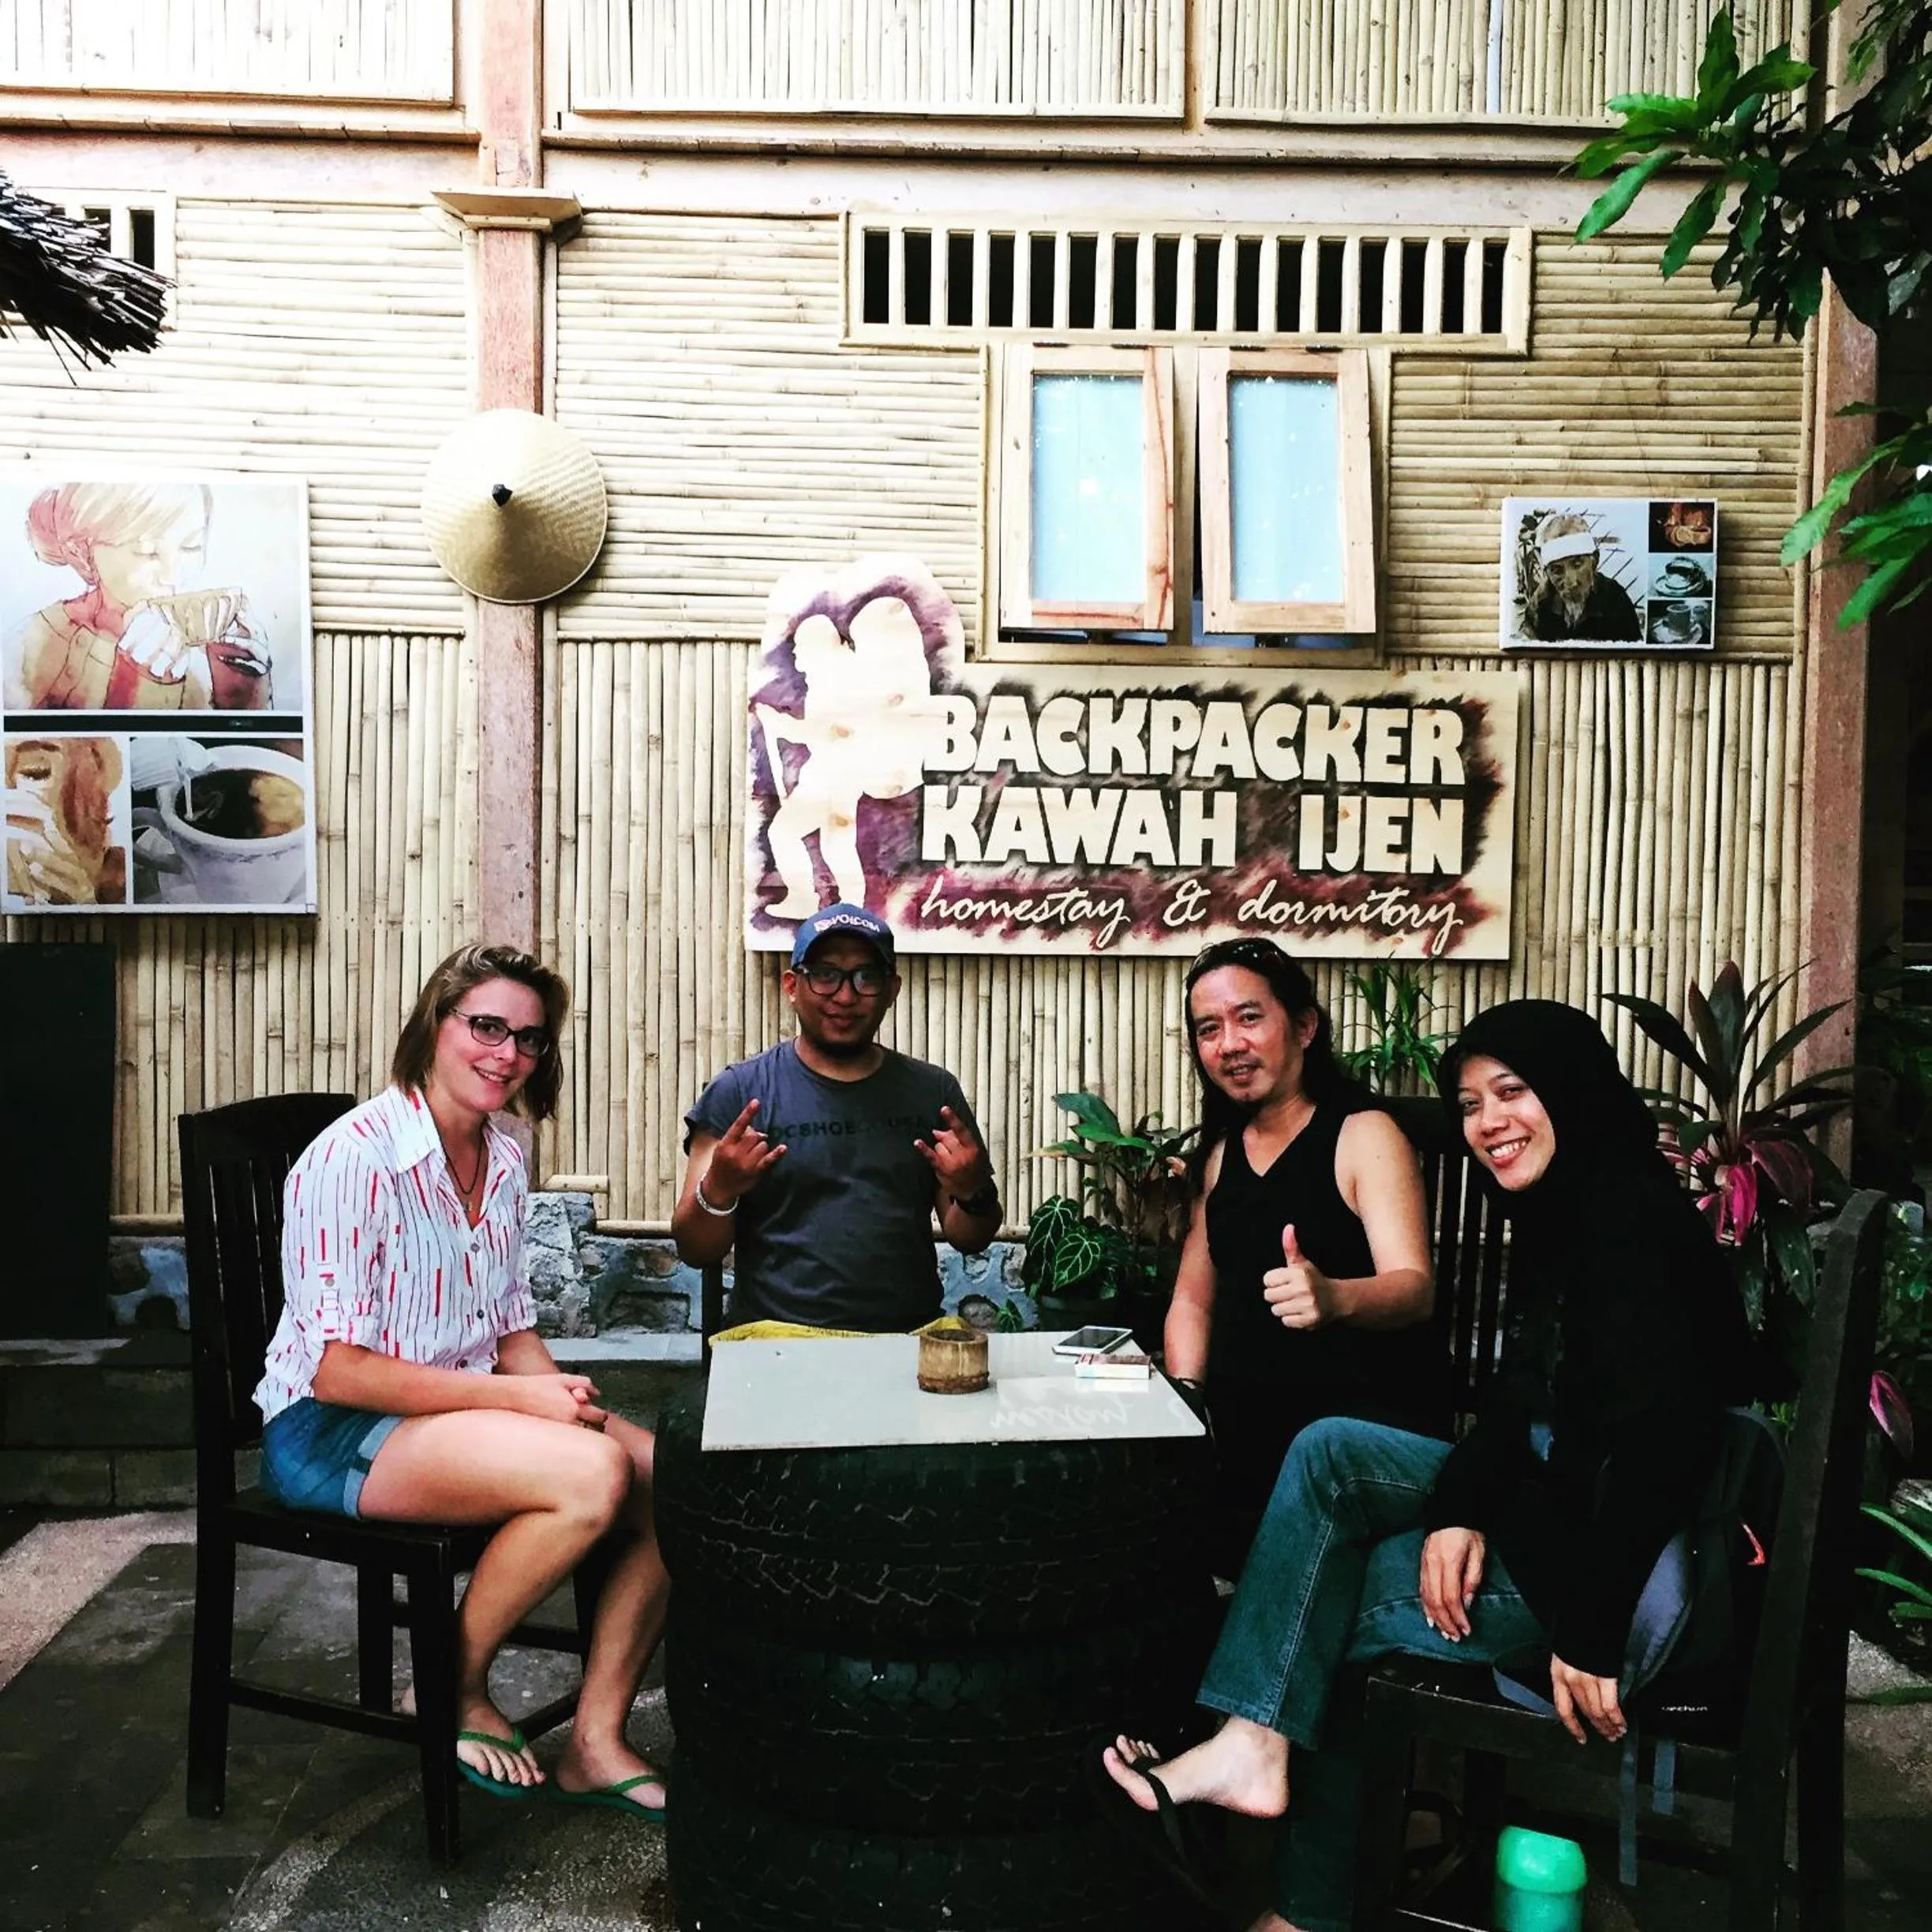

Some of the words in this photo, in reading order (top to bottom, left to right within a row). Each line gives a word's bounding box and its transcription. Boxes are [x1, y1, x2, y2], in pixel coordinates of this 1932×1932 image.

[923, 695, 1466, 786] BACKPACKER
[921, 784, 1237, 868] KAWAH
[1299, 793, 1465, 876] IJEN
[830, 913, 881, 933] VOLCOM
[920, 874, 1132, 950] homestay
[1162, 878, 1211, 928] &
[1237, 878, 1464, 956] dormitory
